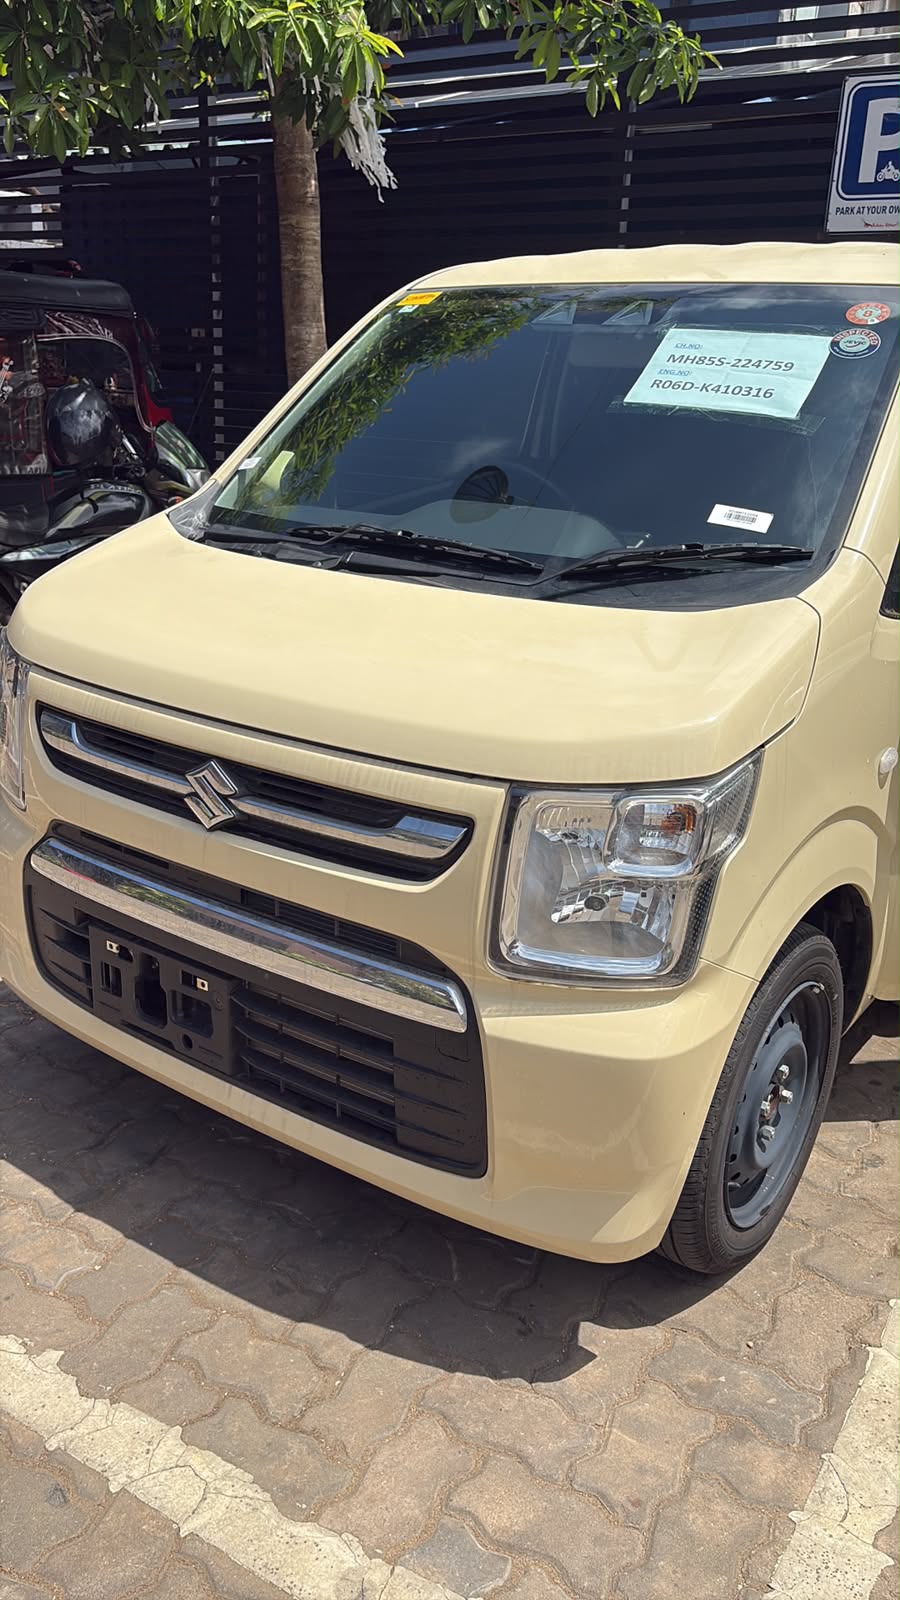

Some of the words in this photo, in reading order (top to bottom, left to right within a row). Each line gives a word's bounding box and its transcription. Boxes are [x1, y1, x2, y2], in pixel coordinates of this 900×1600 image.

[858, 97, 900, 183] P
[835, 206, 855, 215] PARK
[856, 206, 865, 215] AT
[867, 205, 887, 215] YOUR
[832, 329, 879, 345] INSPECTED
[666, 353, 795, 372] MH85S-224759
[650, 379, 775, 399] R06D-K410316
